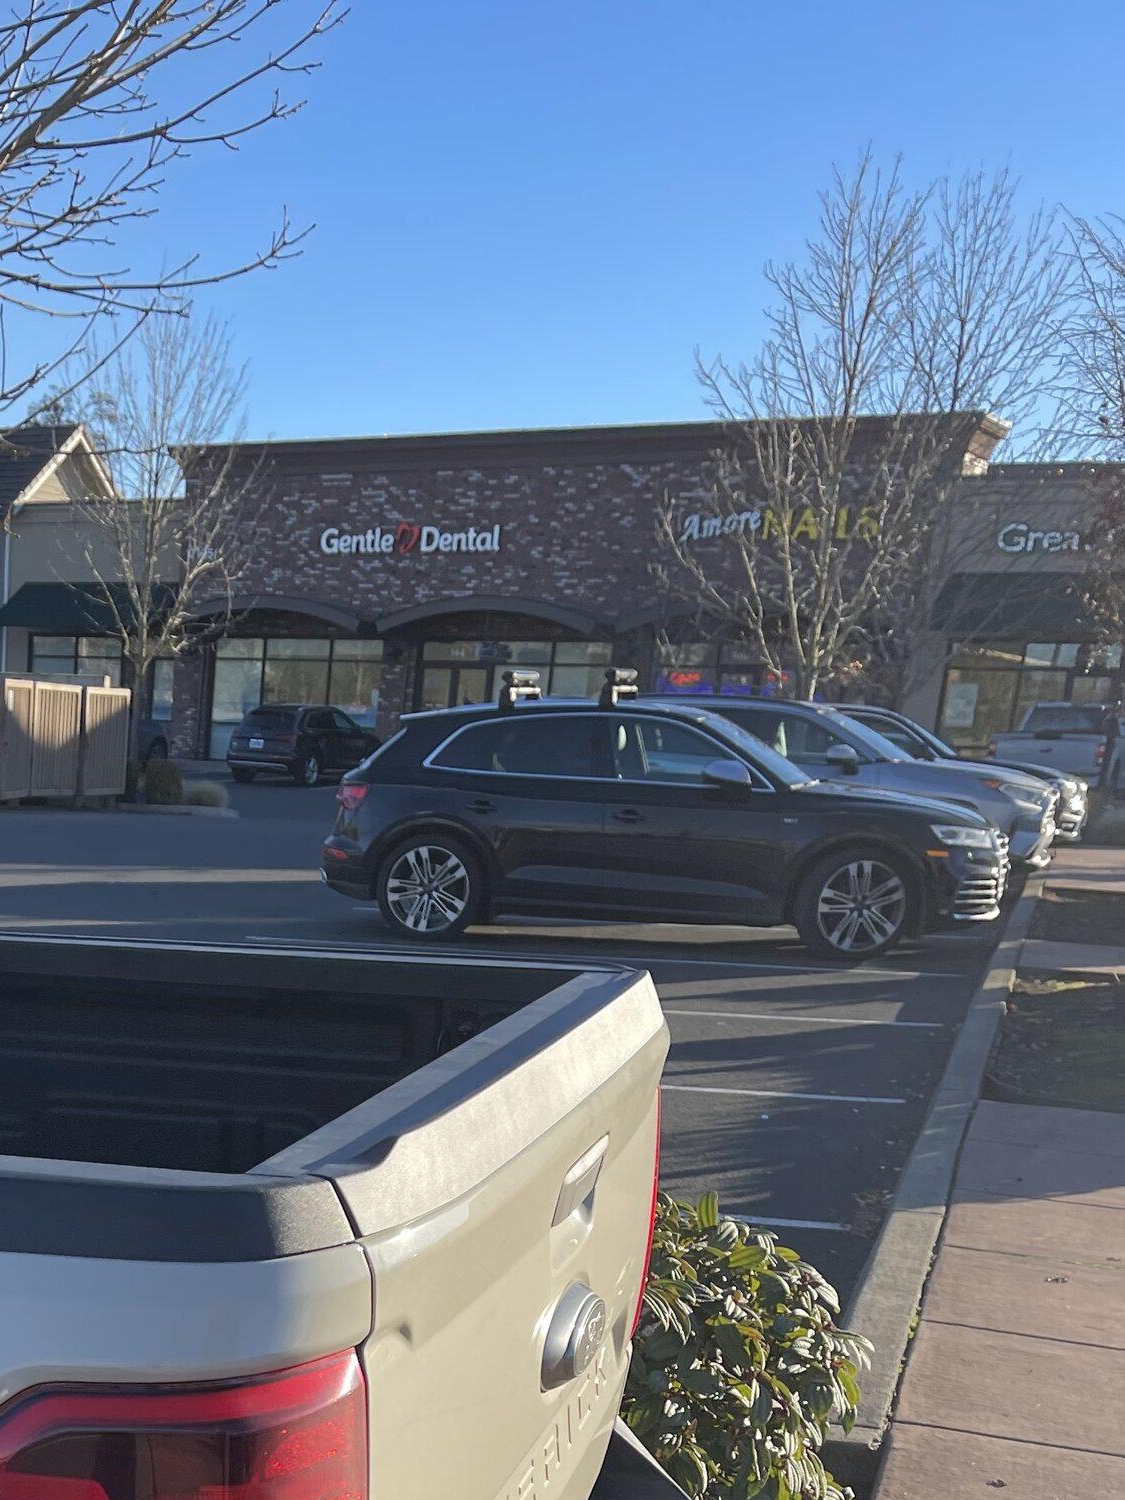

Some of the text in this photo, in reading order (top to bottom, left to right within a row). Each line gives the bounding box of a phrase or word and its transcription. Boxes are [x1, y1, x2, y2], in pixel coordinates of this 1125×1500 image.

[320, 524, 501, 554] Gentle Dental
[679, 506, 881, 542] Amore NALS
[997, 522, 1091, 552] Grea
